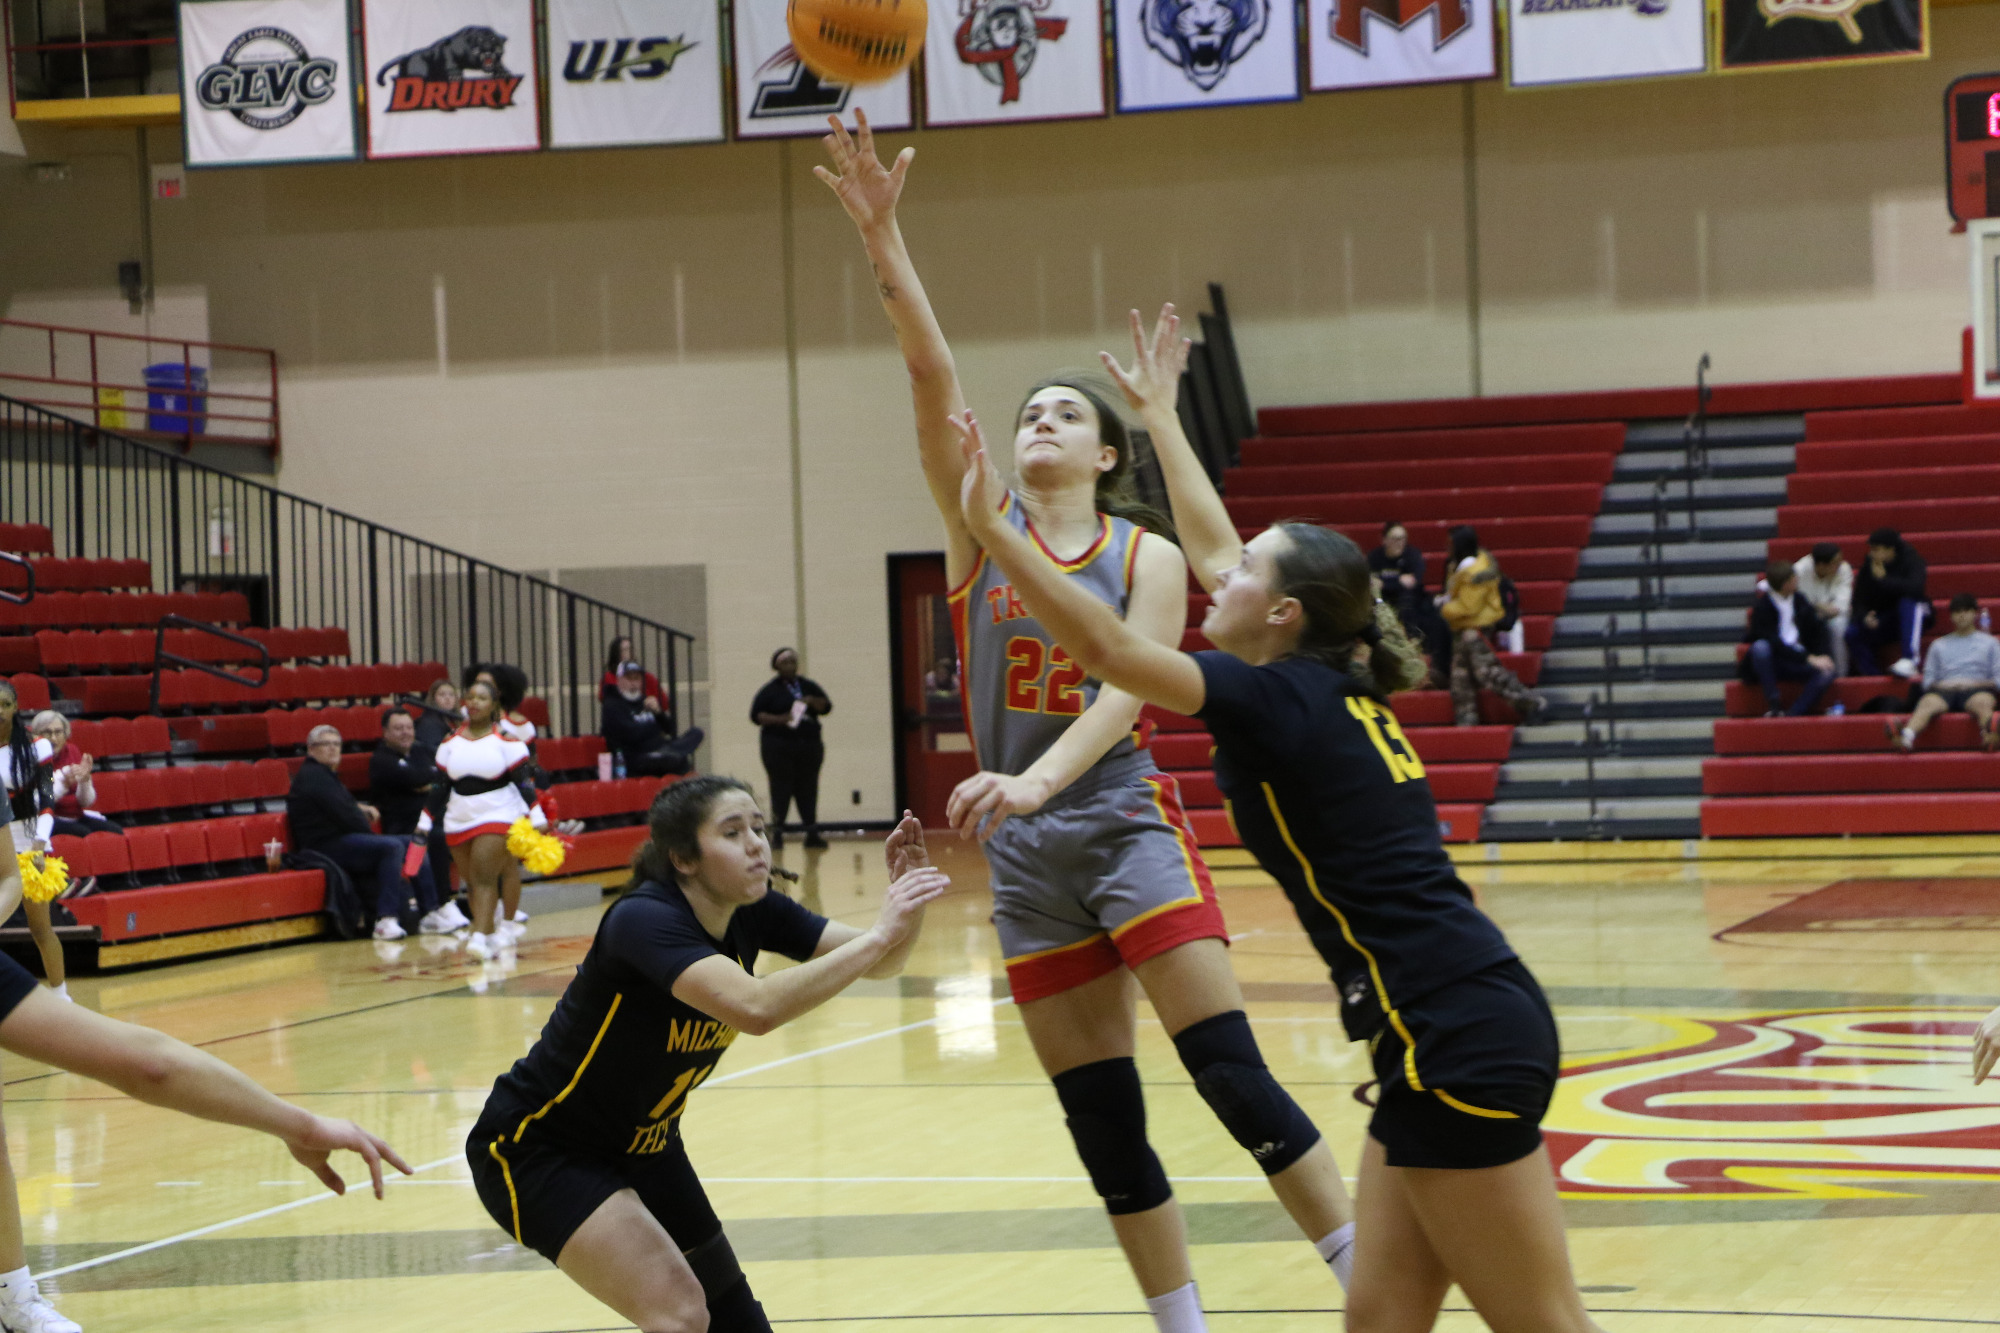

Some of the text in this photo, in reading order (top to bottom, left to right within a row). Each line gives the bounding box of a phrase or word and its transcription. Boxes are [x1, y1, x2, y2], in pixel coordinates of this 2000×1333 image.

[196, 57, 337, 110] GLVC
[563, 36, 670, 82] UIS
[385, 75, 524, 112] DRURY
[1005, 635, 1087, 717] 22
[1344, 696, 1427, 784] 13
